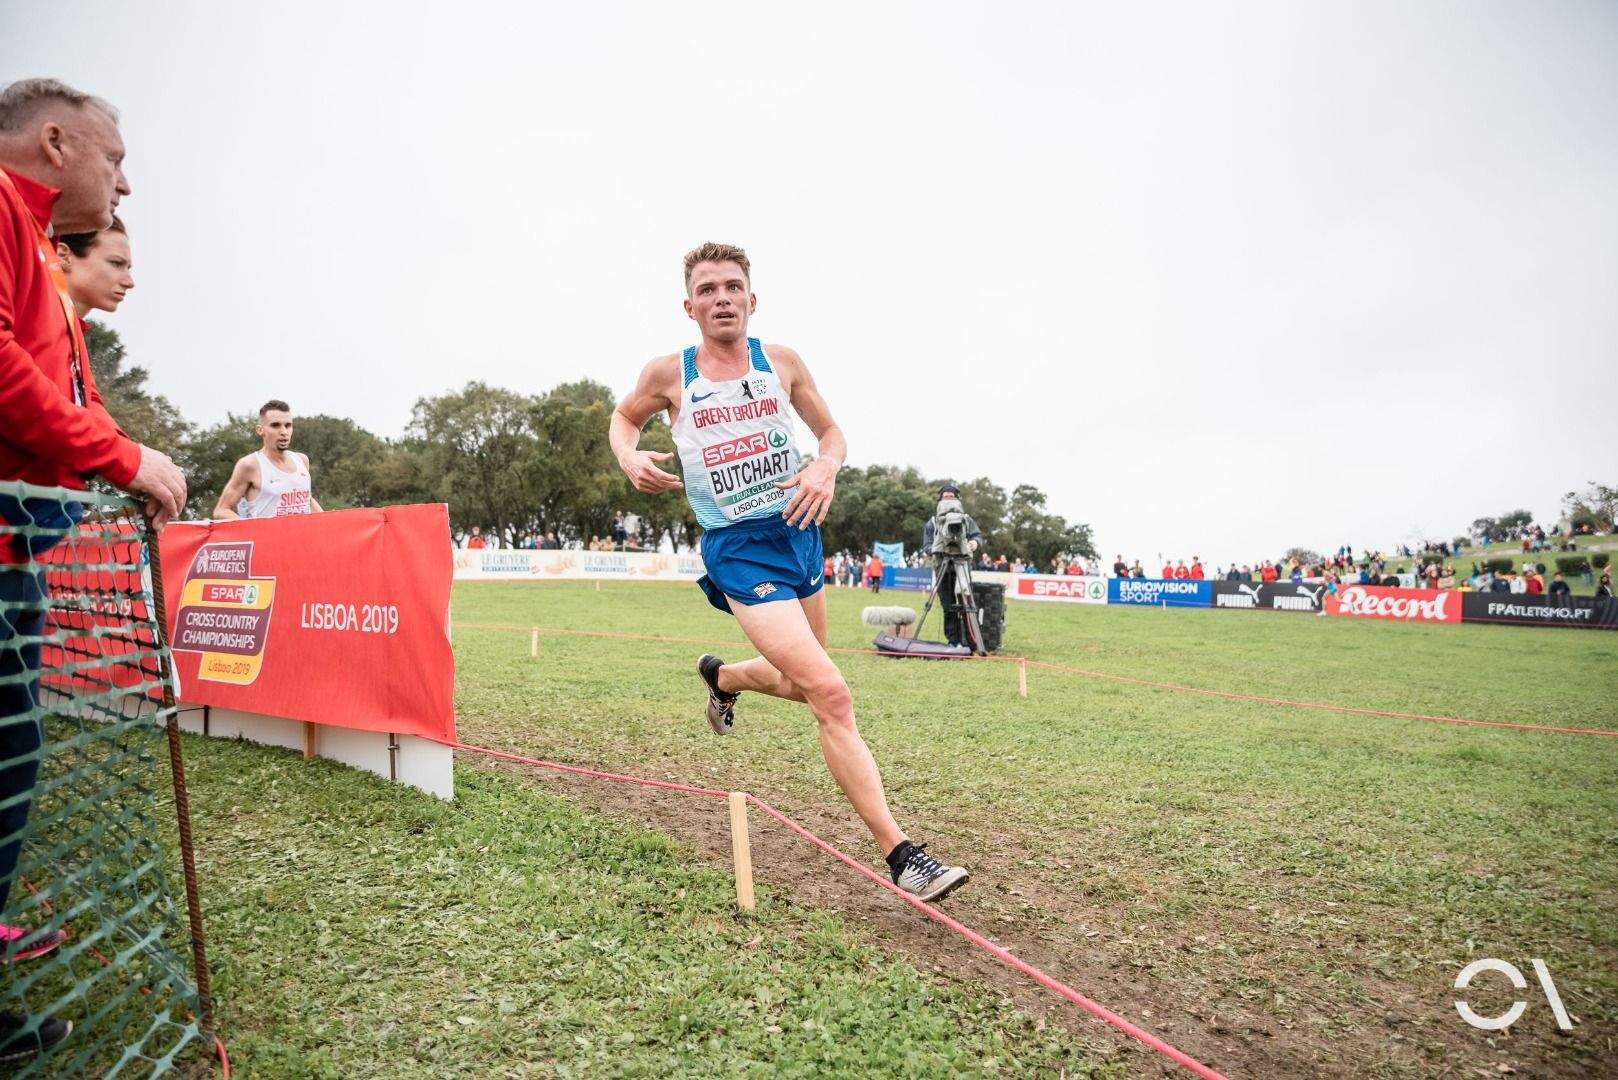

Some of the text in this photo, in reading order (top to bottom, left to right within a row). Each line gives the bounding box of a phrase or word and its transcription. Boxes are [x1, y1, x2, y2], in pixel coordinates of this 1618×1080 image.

[693, 398, 778, 428] GREAT BRITAIN
[704, 435, 767, 464] SPAR
[710, 450, 790, 495] BUTCHART
[734, 489, 785, 515] LISBOA 2019
[736, 489, 751, 500] RUN
[210, 550, 247, 561] EUROPEAN
[208, 562, 246, 573] ATHLETICS
[211, 587, 245, 600] SPAR
[1033, 581, 1085, 597] SPAR
[1119, 581, 1198, 594] EUROVISION
[1119, 592, 1160, 603] SPORT
[1217, 594, 1256, 608] PUMA
[1273, 596, 1315, 610] PUMA
[1339, 586, 1449, 620] Record
[301, 603, 399, 634] LISBOA 2019
[1488, 602, 1592, 620] FPATLETISMO.PT
[186, 612, 260, 630] CROSS COUNTRY
[182, 630, 256, 649] CHAMPIONSHIPS
[208, 660, 251, 675] Lisboa 2019
